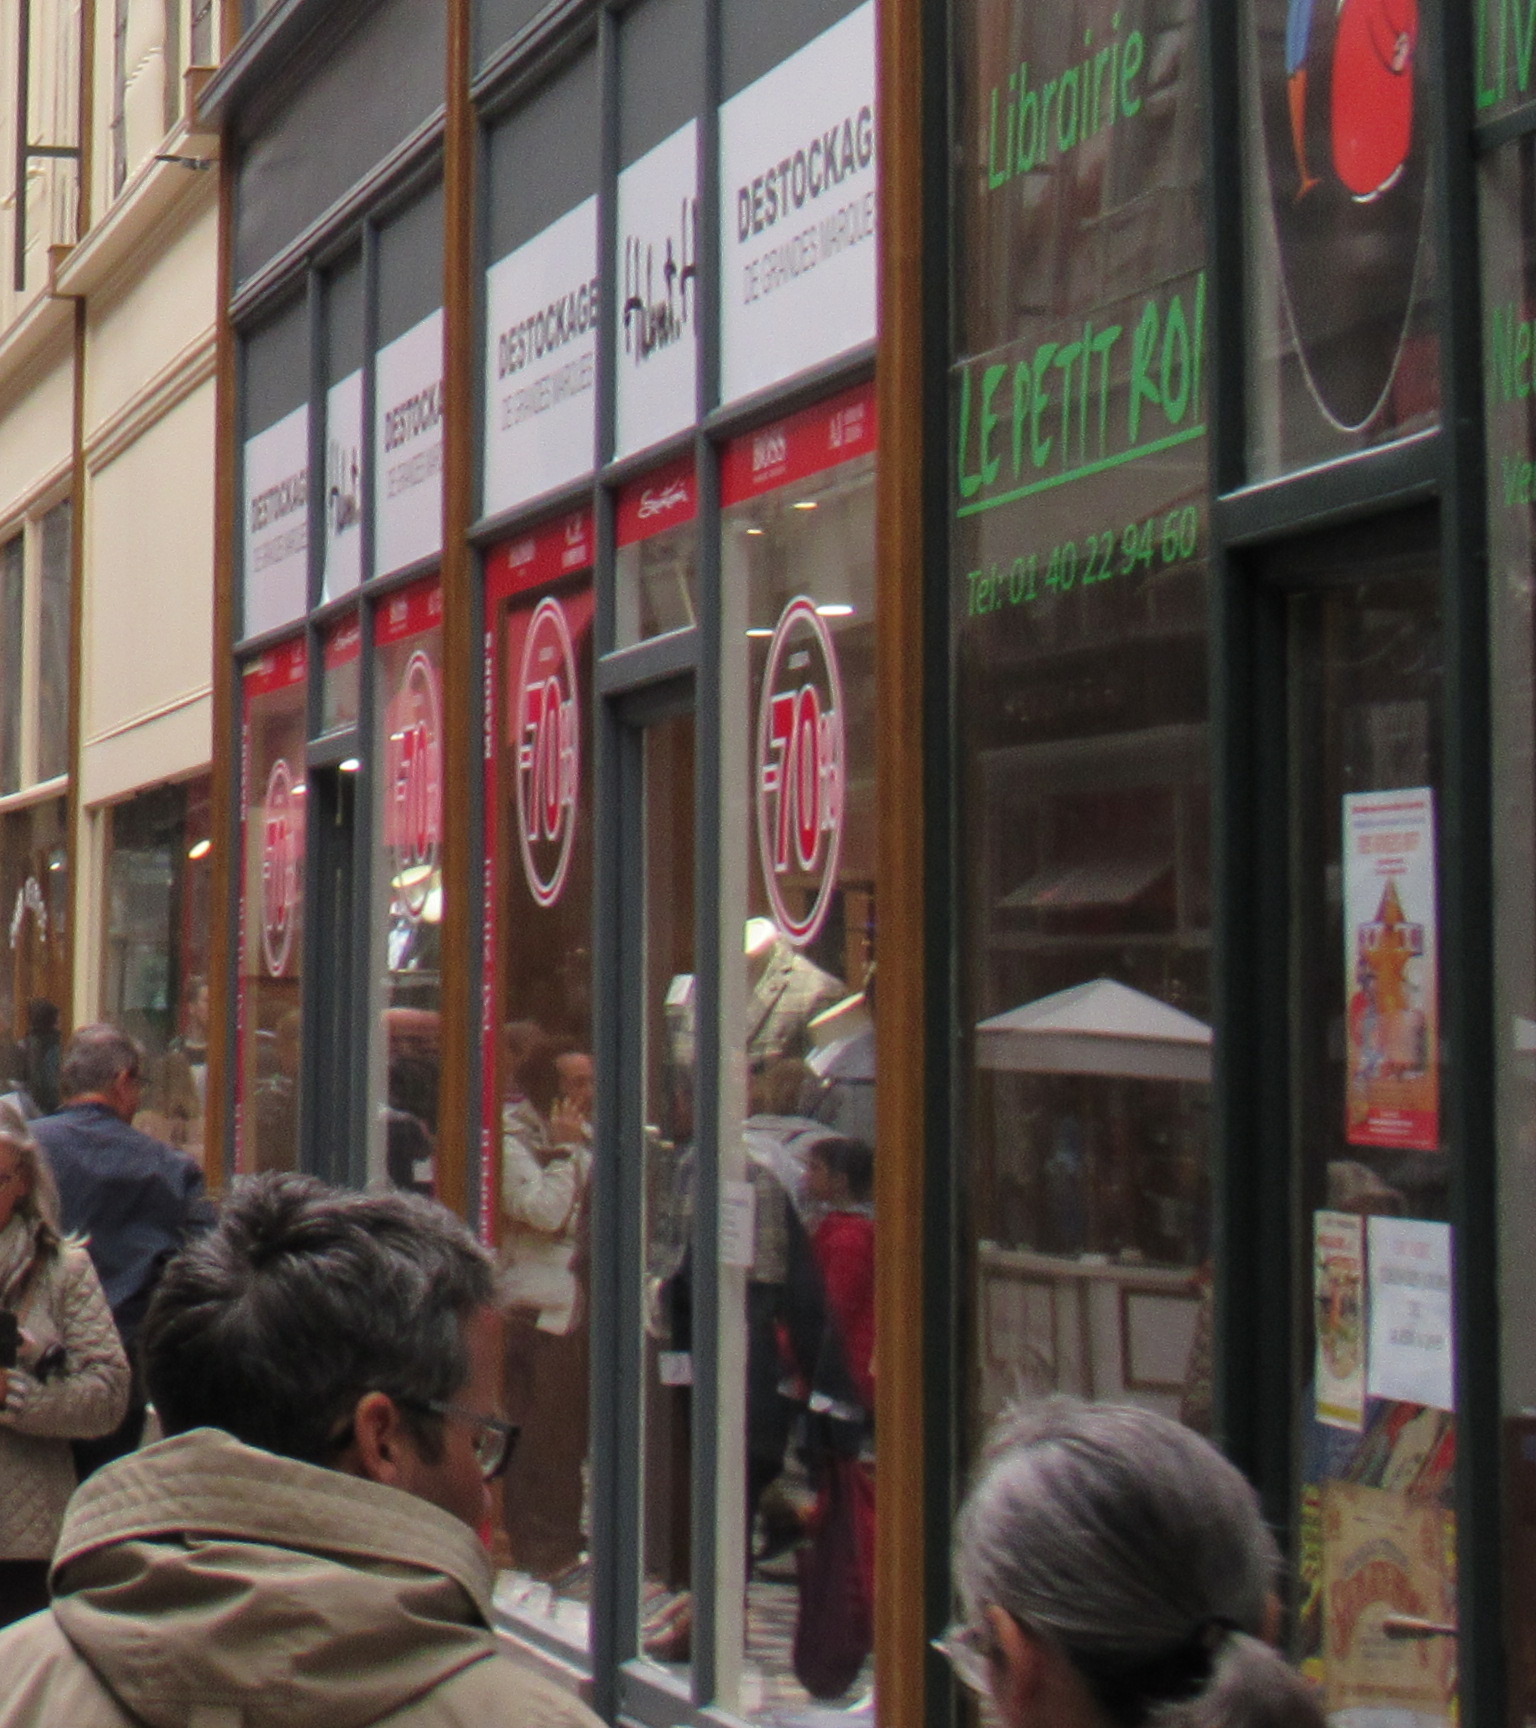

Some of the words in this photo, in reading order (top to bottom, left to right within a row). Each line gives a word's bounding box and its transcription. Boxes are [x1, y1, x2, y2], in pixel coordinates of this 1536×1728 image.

[987, 14, 1144, 191] Librairie
[958, 364, 1008, 497] LE
[1013, 321, 1123, 481] PETIT
[1129, 272, 1206, 443] ROI
[1011, 553, 1038, 604] 01
[1045, 541, 1076, 593] 40
[1083, 530, 1114, 585] 22
[1121, 518, 1154, 575] 94
[1162, 505, 1198, 563] 60
